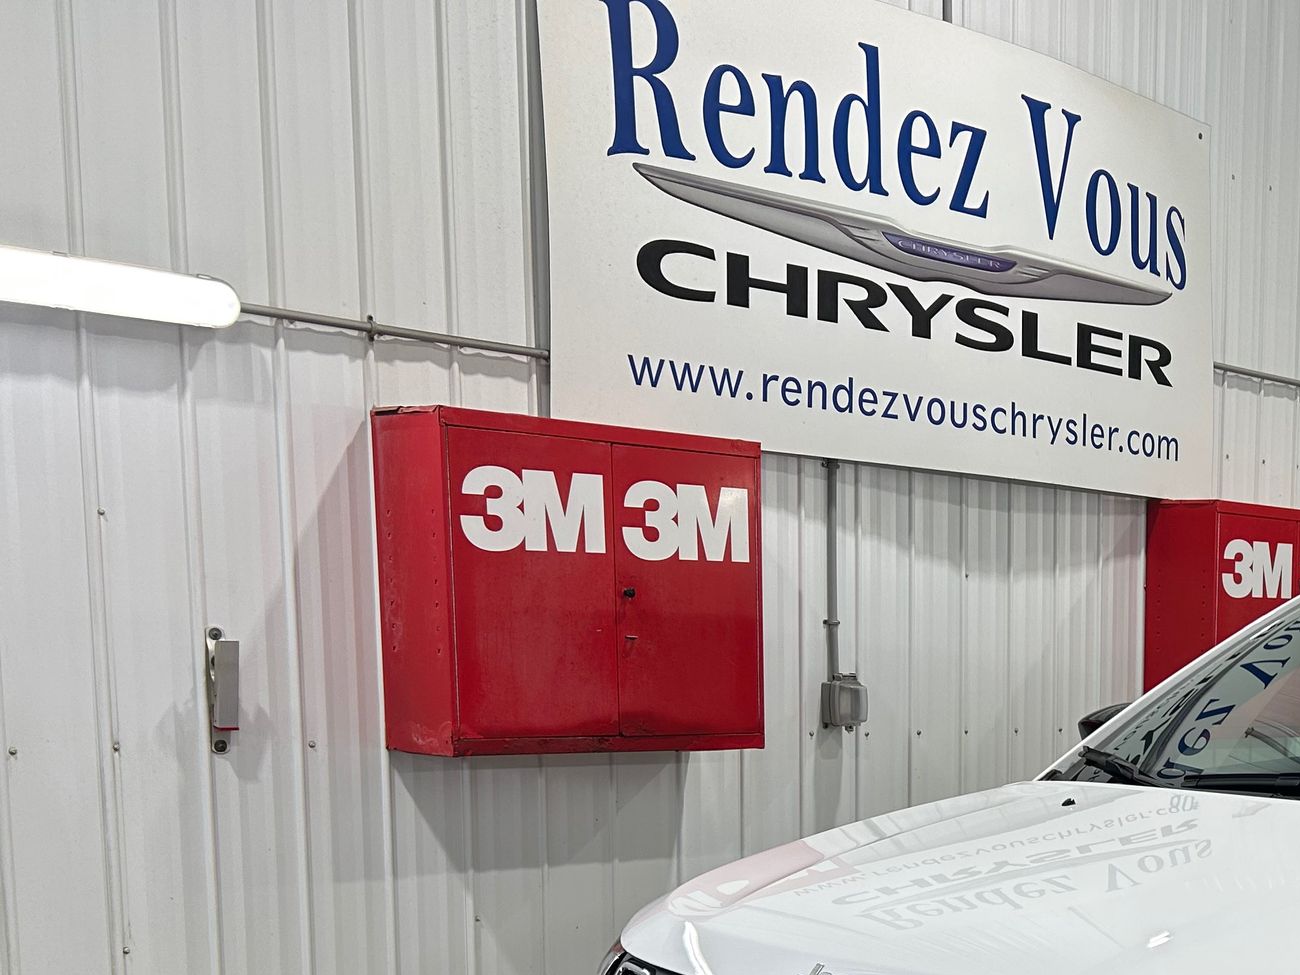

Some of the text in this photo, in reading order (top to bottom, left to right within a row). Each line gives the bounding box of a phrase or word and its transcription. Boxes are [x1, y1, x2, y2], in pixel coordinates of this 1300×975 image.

[607, 0, 1187, 291] Rendez Vous
[897, 240, 1001, 269] CHRYSLER
[636, 239, 1173, 388] CHRYSLER
[627, 353, 1180, 462] www.rendezvouschrysler.com
[459, 465, 750, 563] 3M 3M
[1222, 539, 1294, 599] 3M
